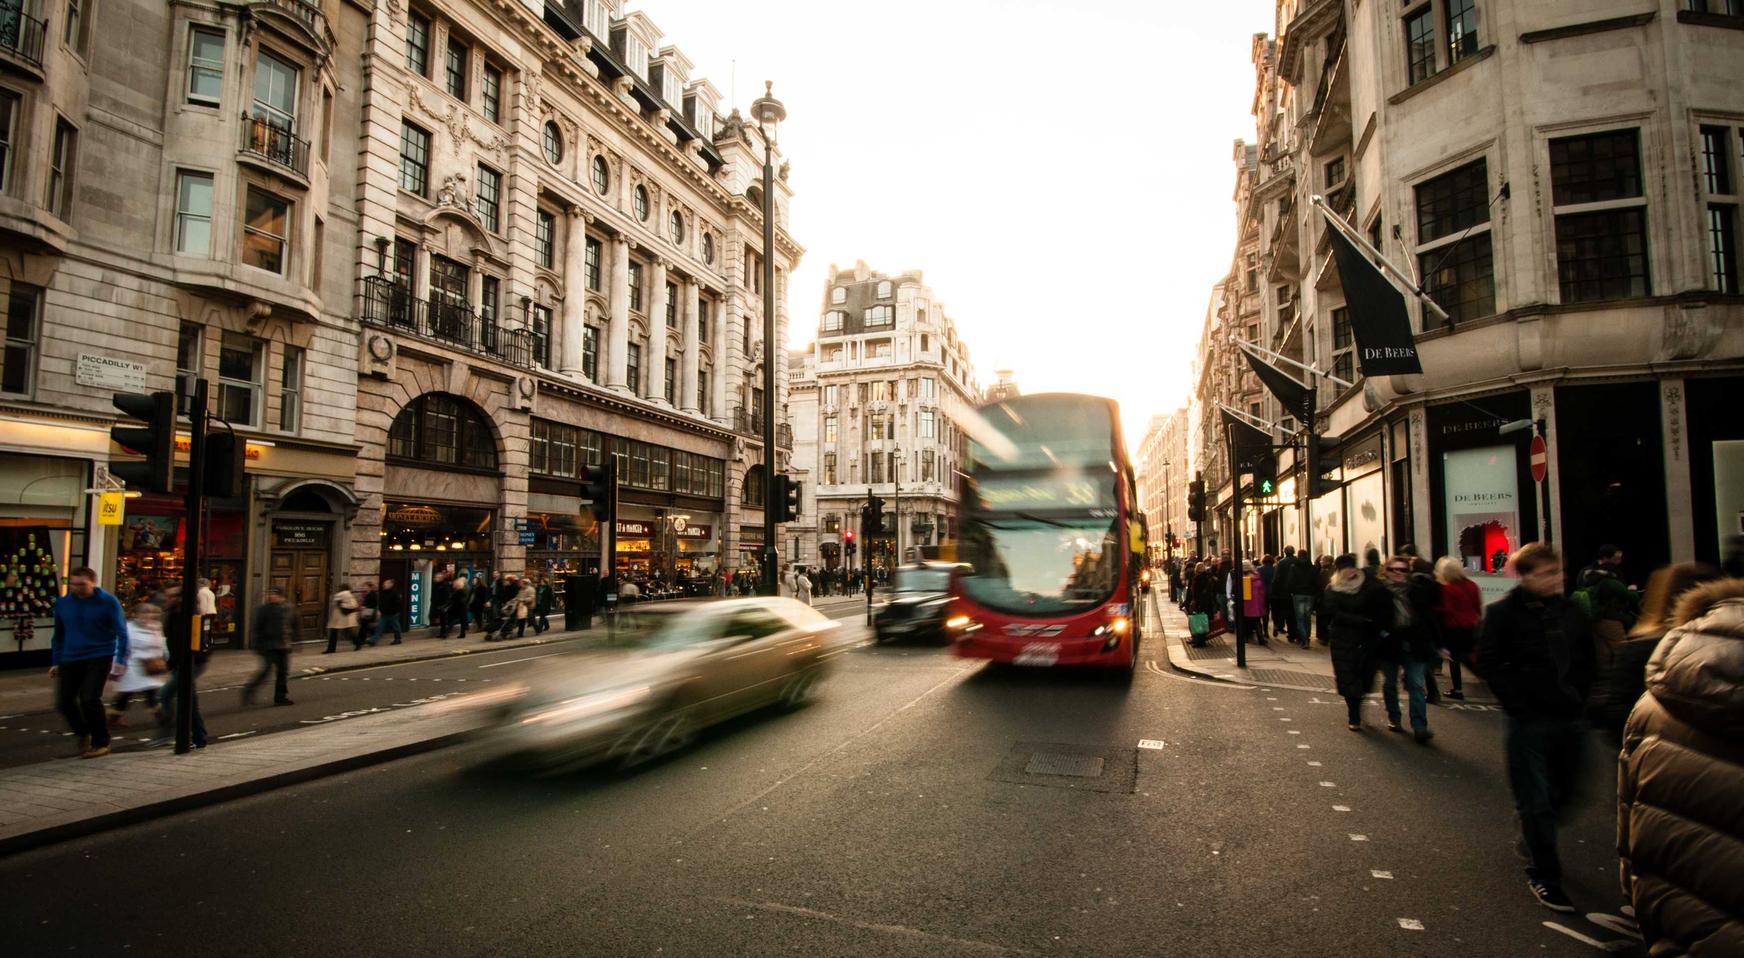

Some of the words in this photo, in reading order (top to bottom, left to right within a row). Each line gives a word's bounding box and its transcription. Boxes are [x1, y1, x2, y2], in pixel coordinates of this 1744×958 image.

[1365, 348, 1382, 360] DE
[1385, 347, 1414, 358] BEERS
[82, 355, 130, 369] PICCADILLY
[1442, 423, 1461, 434] DE
[1473, 493, 1512, 501] BEERS
[103, 500, 117, 513] itsu
[411, 572, 420, 624] MONEY
